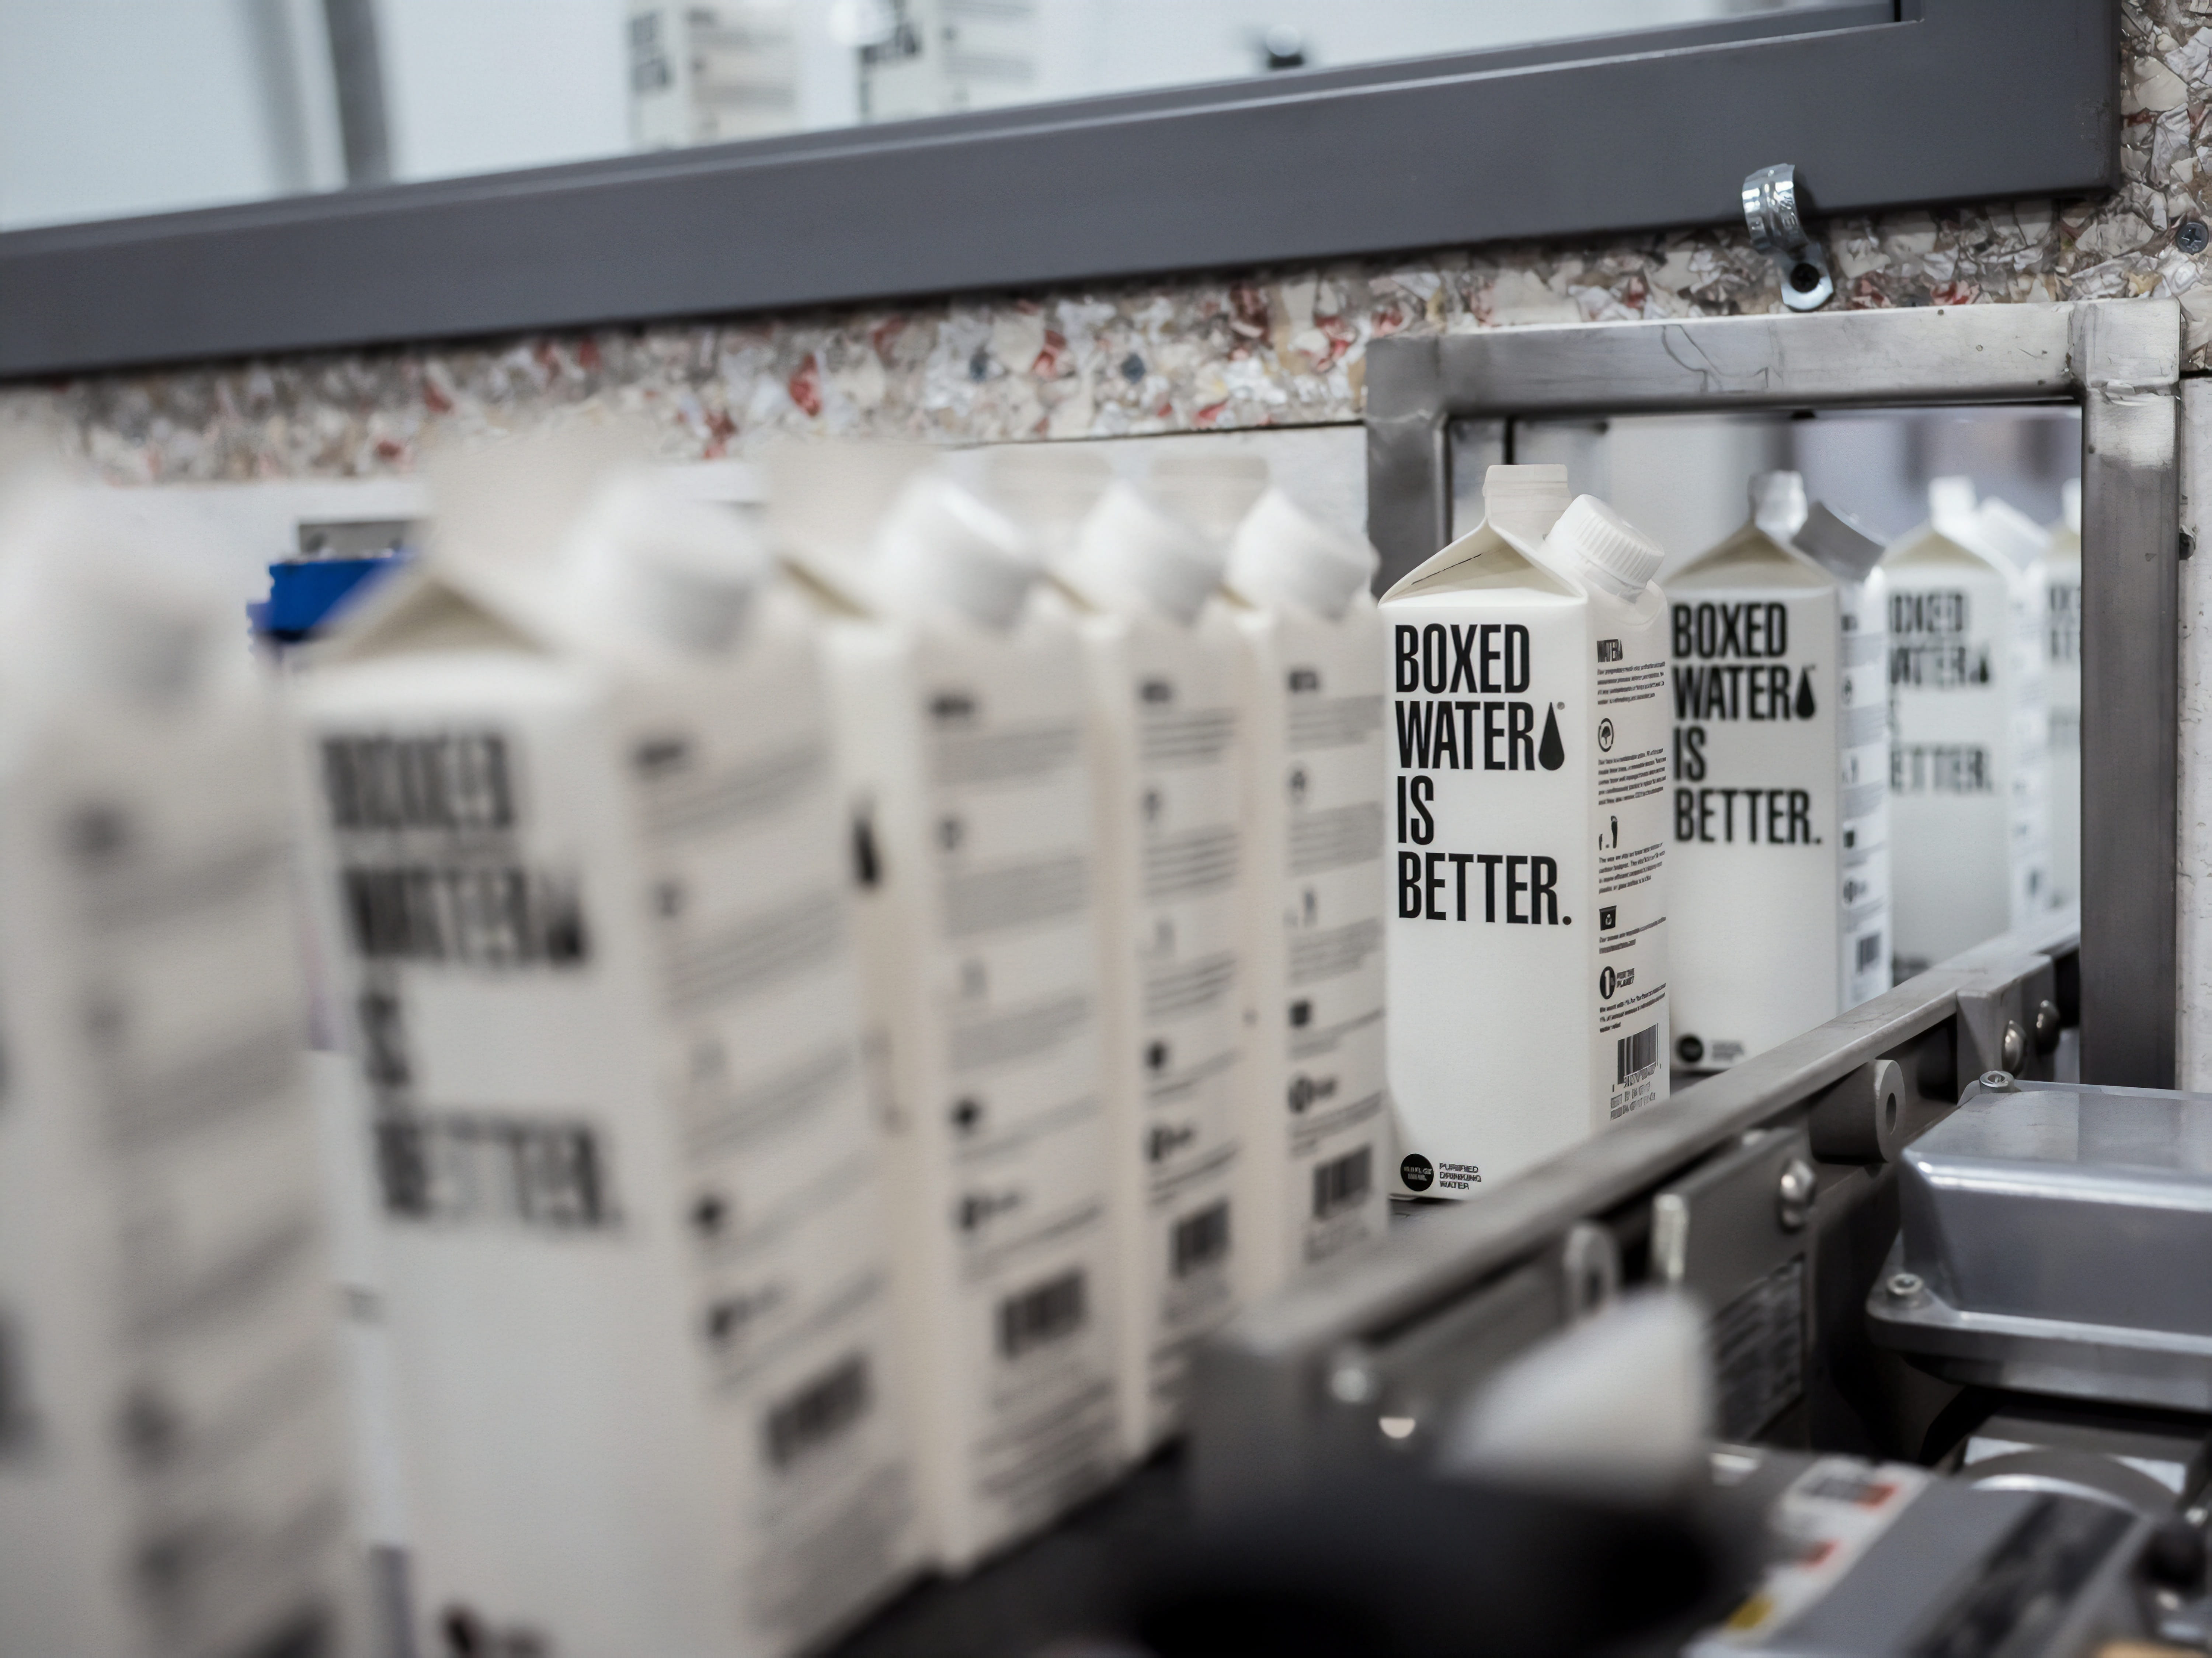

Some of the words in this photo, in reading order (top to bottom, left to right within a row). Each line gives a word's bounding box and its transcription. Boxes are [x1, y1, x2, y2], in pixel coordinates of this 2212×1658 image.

[1395, 623, 1530, 694] BOXED
[1672, 602, 1788, 660] BOXED
[1672, 664, 1792, 721] WATER
[1395, 700, 1535, 771] WATER
[1673, 725, 1707, 783] IS
[1397, 775, 1434, 845] IS
[1674, 787, 1822, 844] BETTER.
[1398, 851, 1572, 925] BETTER.
